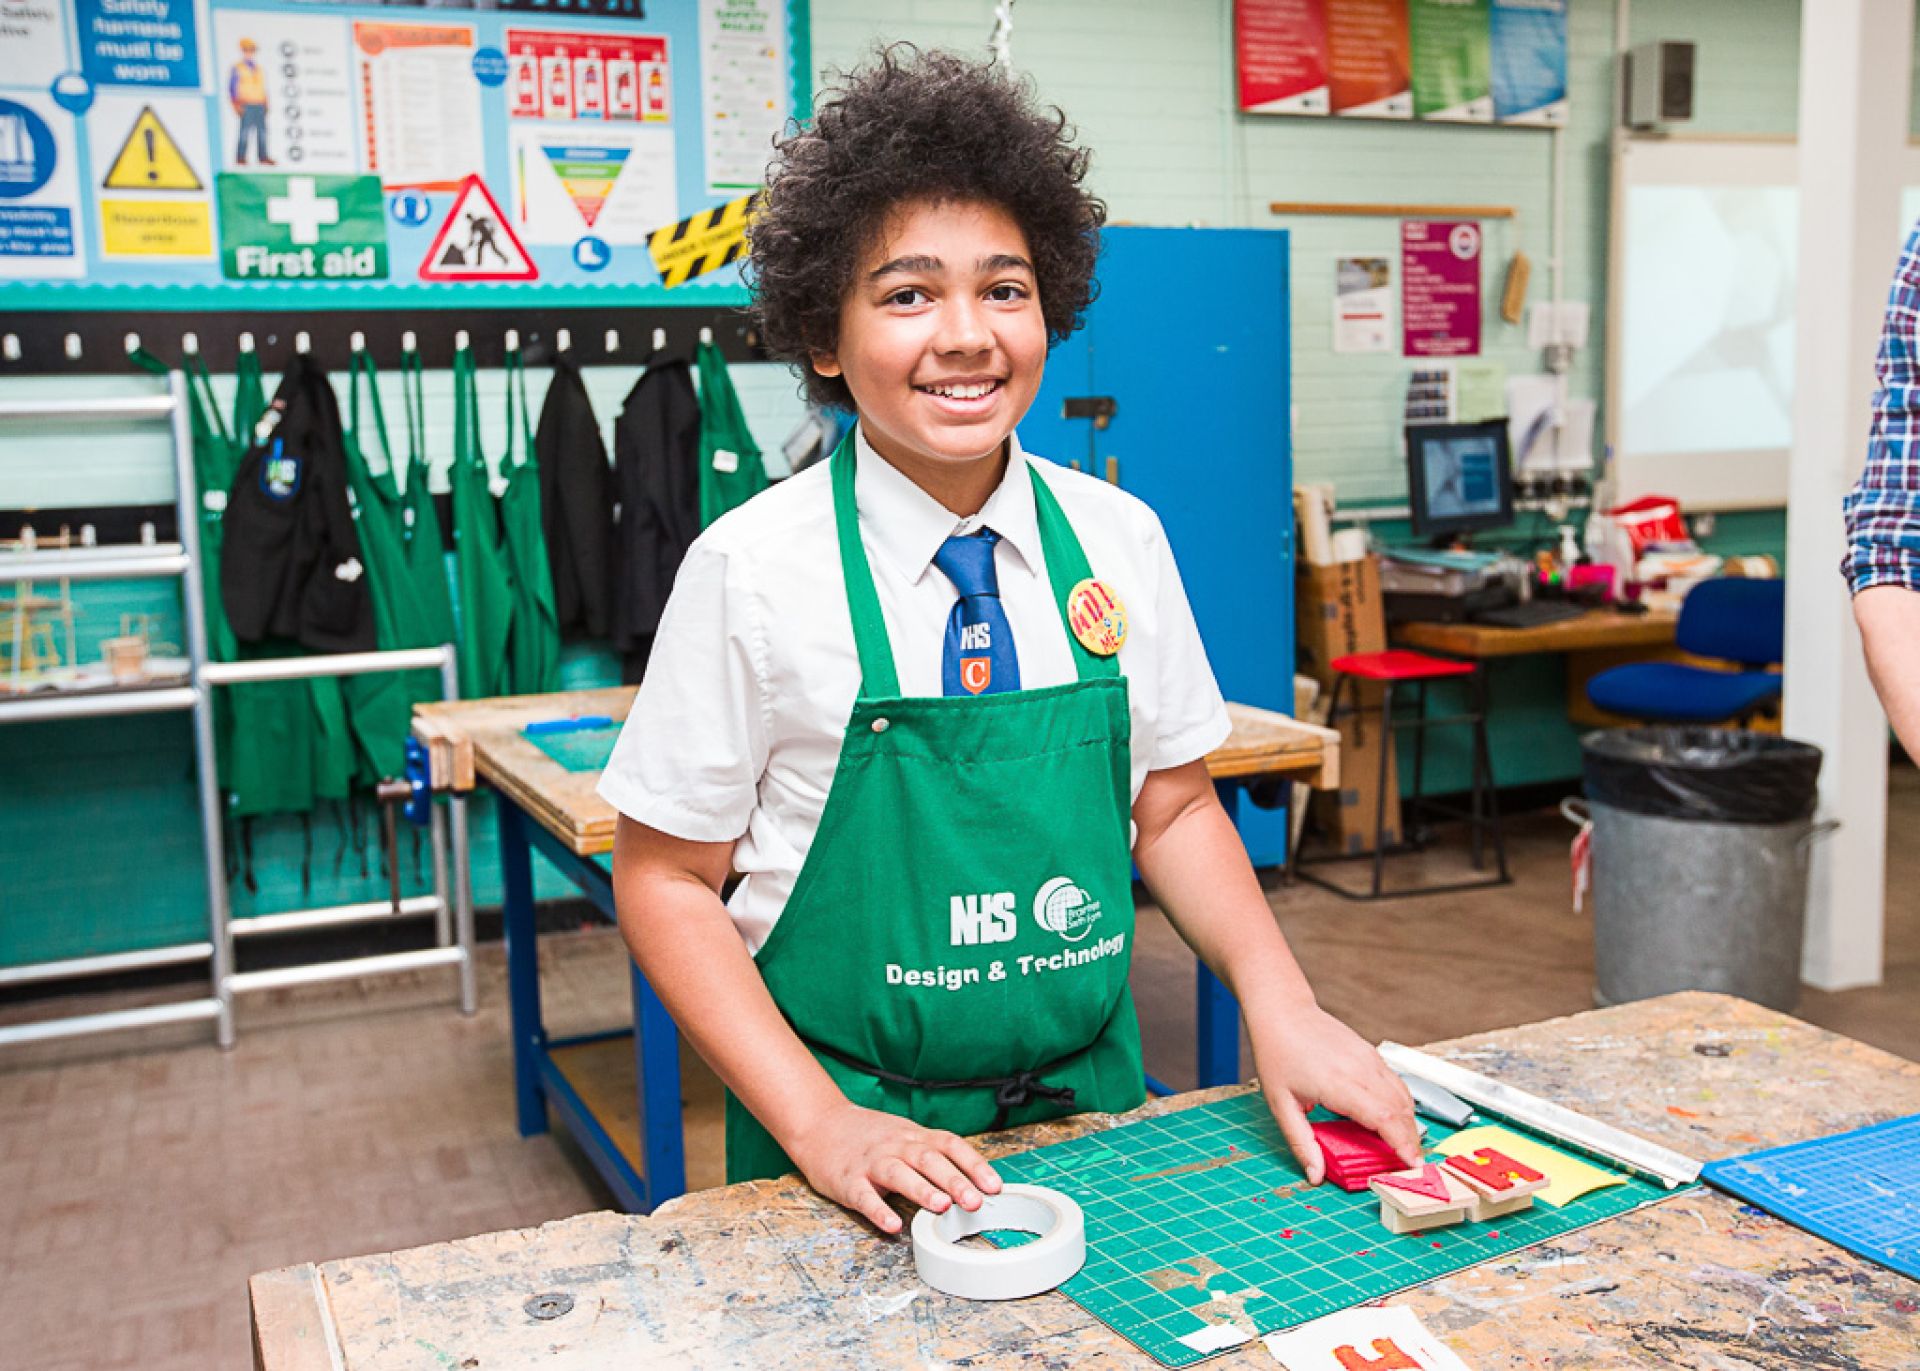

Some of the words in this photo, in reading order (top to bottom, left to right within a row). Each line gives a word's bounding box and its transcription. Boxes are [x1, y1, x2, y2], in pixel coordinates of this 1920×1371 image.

[95, 41, 152, 59] must
[154, 43, 184, 61] be
[113, 65, 170, 81] worn
[236, 245, 317, 277] First
[323, 246, 376, 277] aid
[961, 622, 991, 650] NHS
[965, 660, 987, 688] C
[950, 891, 1017, 946] NHS
[885, 963, 980, 991] Design
[987, 960, 1007, 982] &
[1016, 932, 1126, 976] Technology
